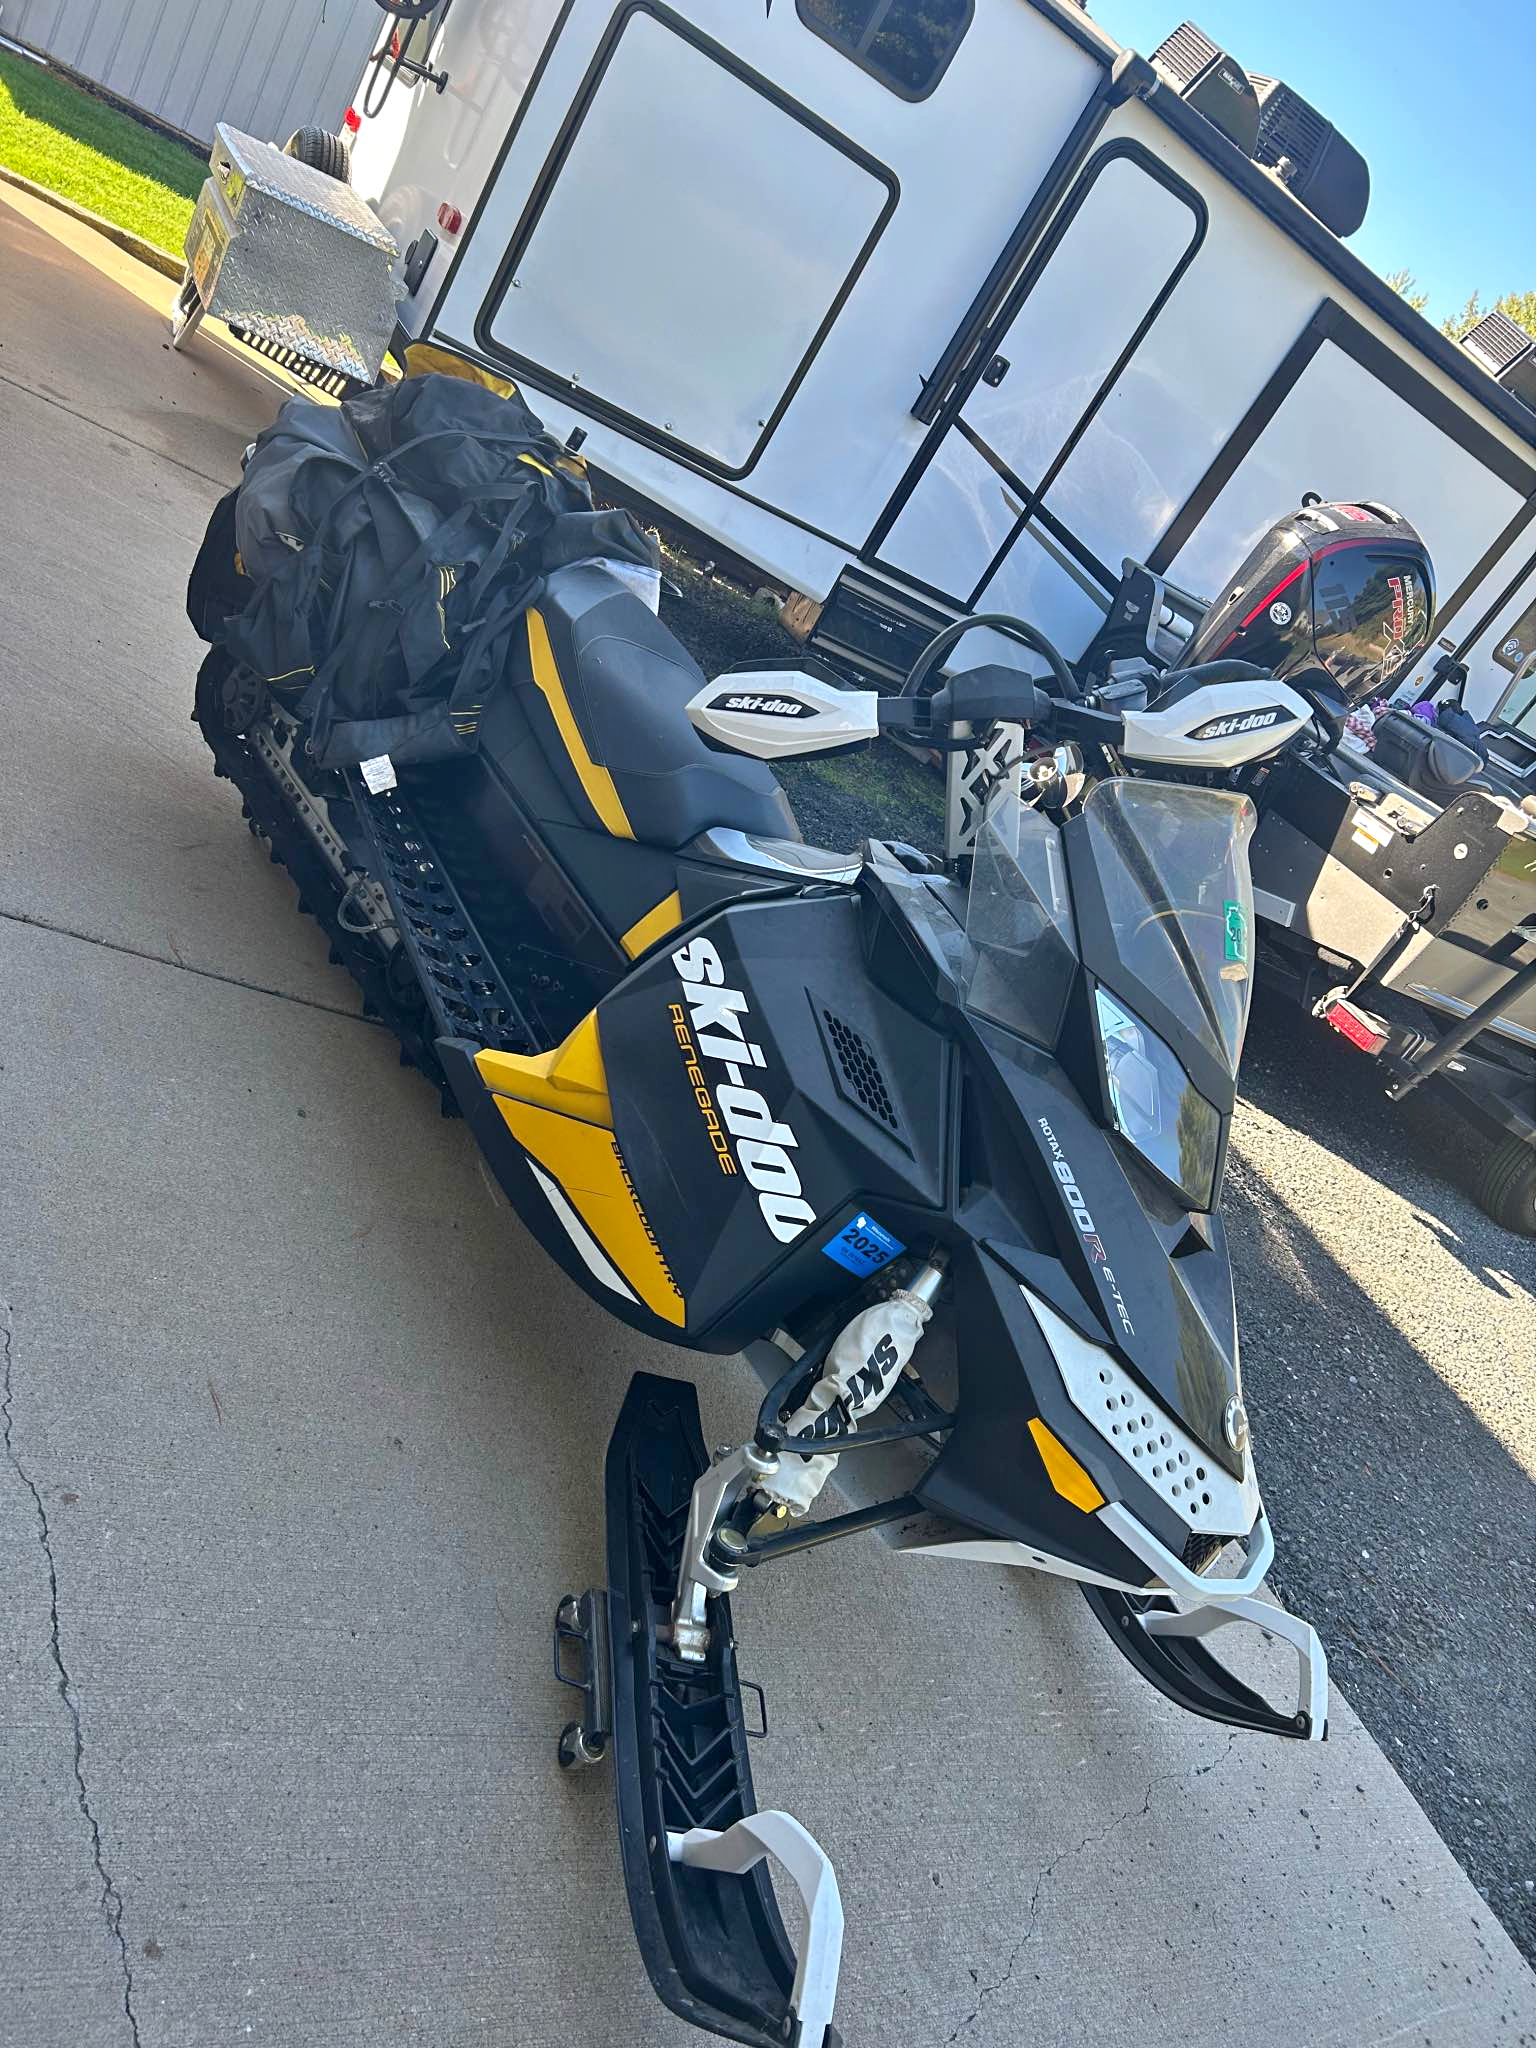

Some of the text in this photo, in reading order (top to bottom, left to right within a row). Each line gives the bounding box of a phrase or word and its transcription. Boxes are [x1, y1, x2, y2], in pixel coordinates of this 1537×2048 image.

[1403, 574, 1414, 626] MERCURY
[725, 696, 803, 715] ski-doo
[1202, 712, 1278, 739] ski-doo
[668, 1003, 738, 1175] RENEGADE
[671, 937, 817, 1244] ski-doo
[841, 1228, 890, 1264] 2025
[1037, 1117, 1136, 1337] ROTAX 800R E-TEC
